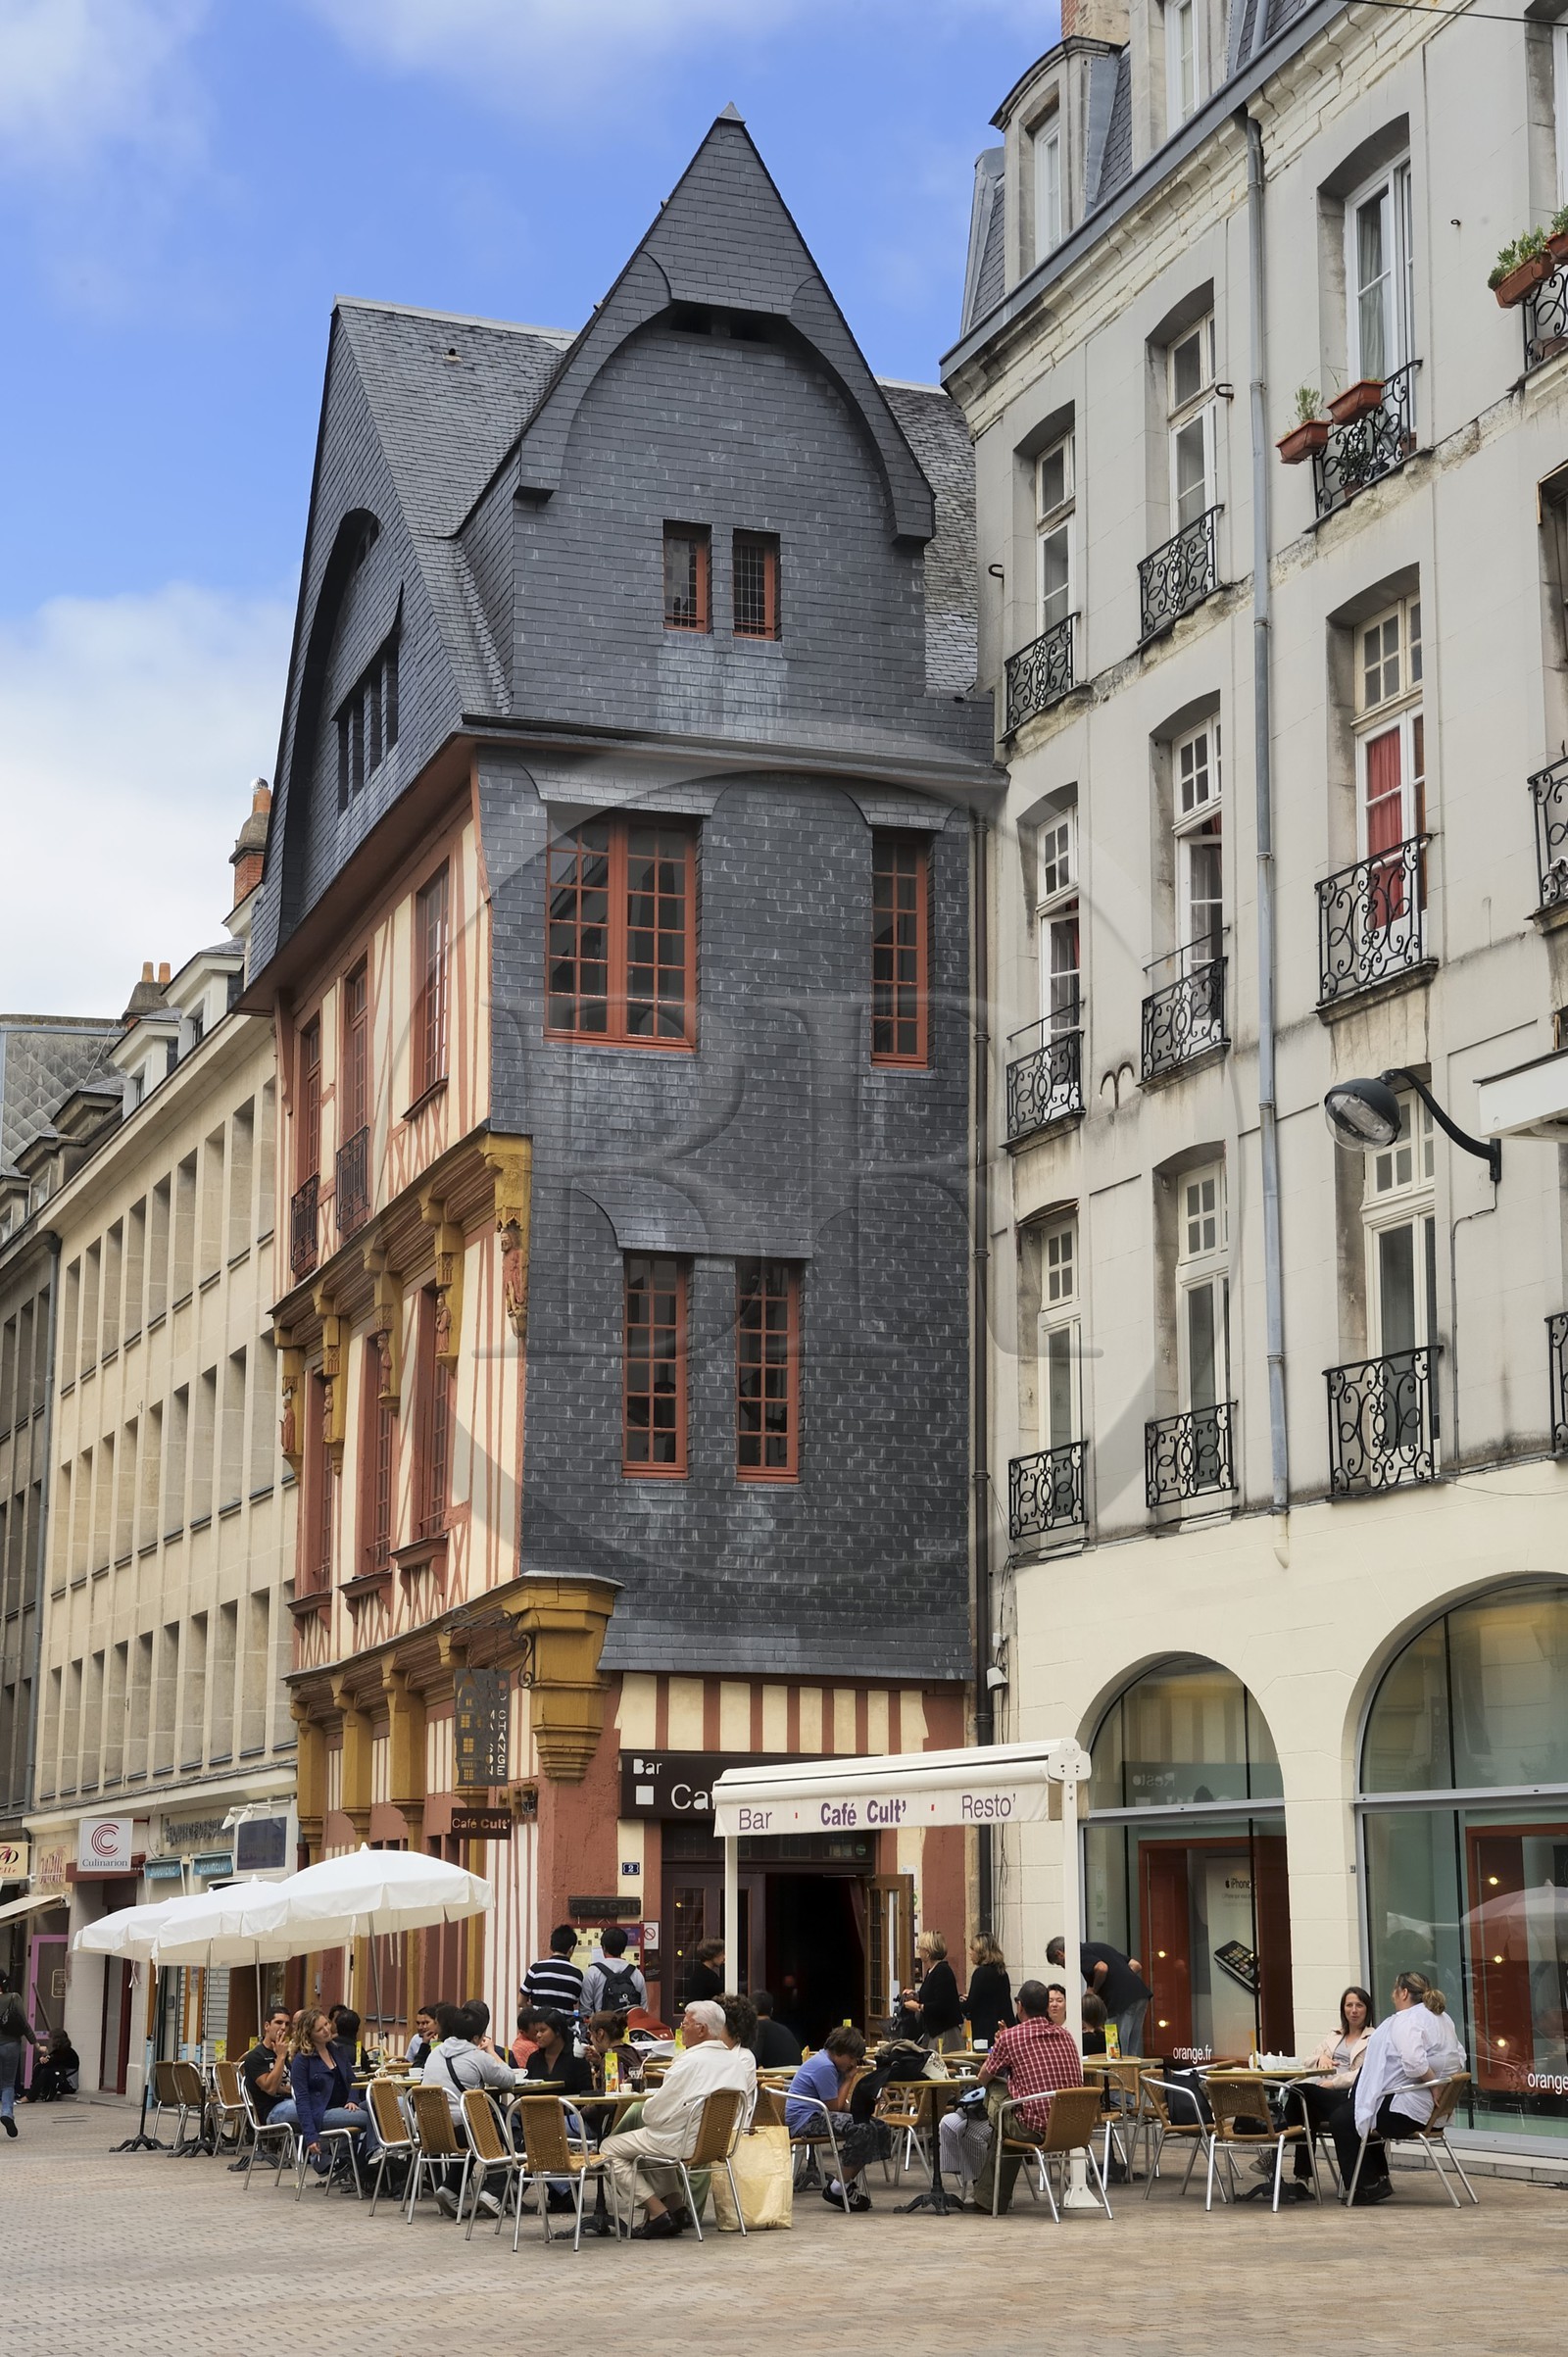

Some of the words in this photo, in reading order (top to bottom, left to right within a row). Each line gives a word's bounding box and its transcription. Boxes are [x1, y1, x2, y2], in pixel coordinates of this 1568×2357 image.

[498, 1680, 508, 1700] DU
[496, 1709, 507, 1776] CHANGE
[633, 1758, 662, 1775] Bar
[670, 1783, 716, 1810] Ca
[739, 1808, 772, 1831] Bar
[820, 1802, 857, 1827] Café
[961, 1792, 1016, 1820] Resto'
[452, 1817, 477, 1829] Café
[480, 1818, 511, 1830] Cult'
[82, 1858, 128, 1867] Culinarion
[627, 1864, 634, 1873] 2
[1173, 2044, 1212, 2064] orange.fr
[1527, 2073, 1568, 2095] orange
